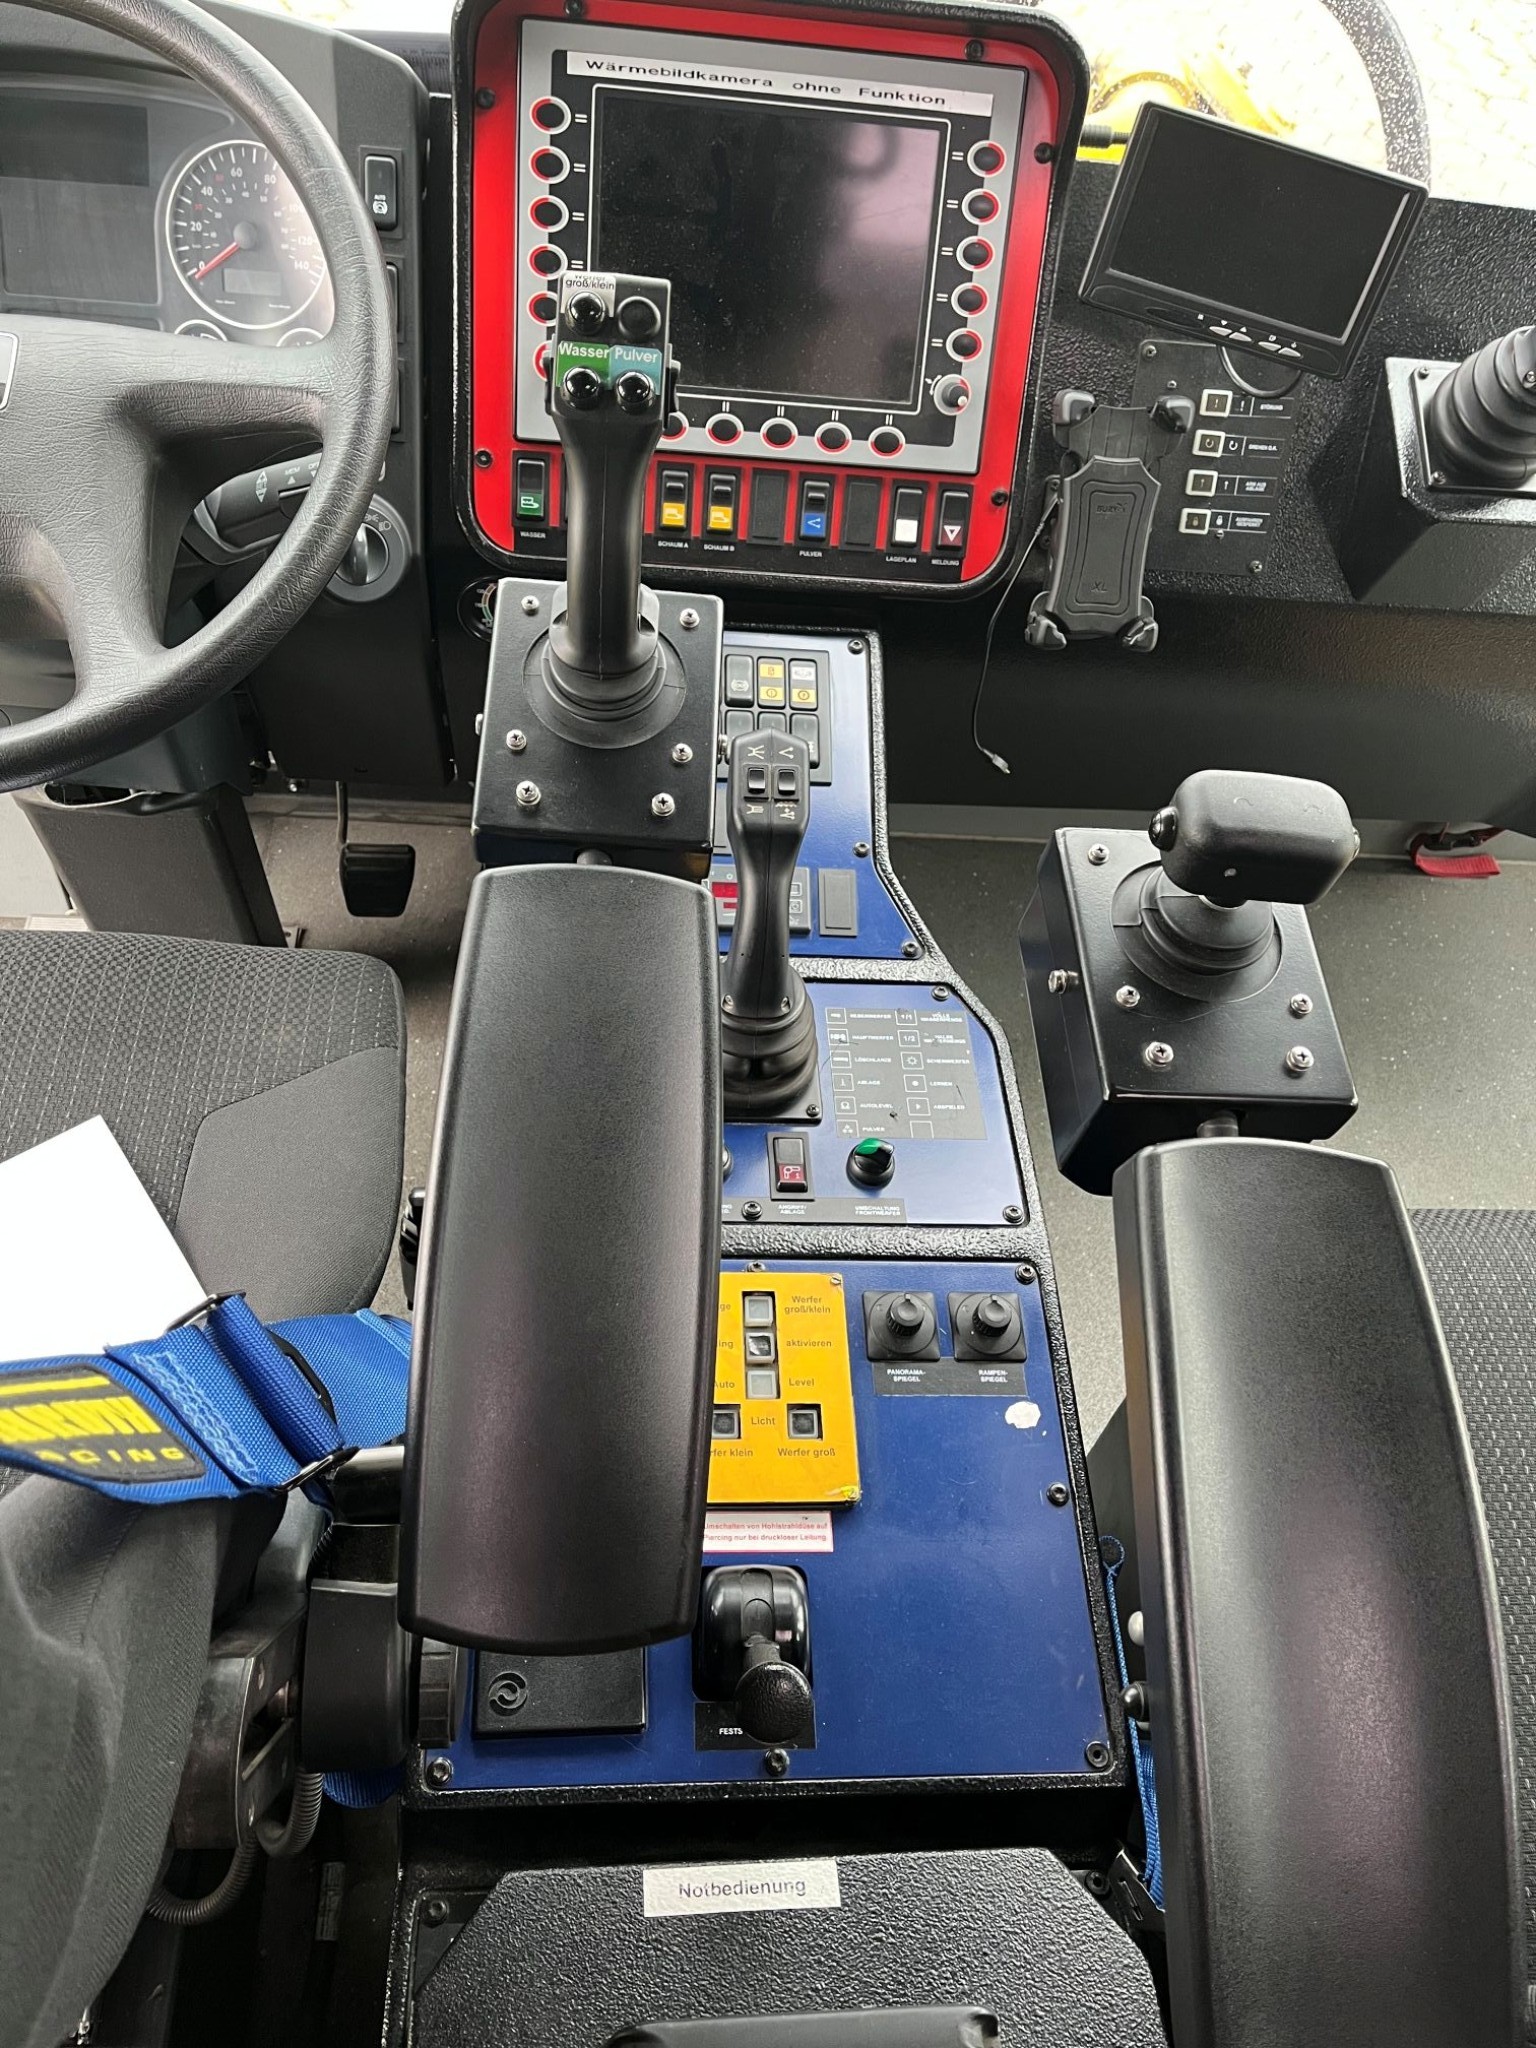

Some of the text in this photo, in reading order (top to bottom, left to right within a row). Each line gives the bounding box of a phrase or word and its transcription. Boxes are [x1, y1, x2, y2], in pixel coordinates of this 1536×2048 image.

[586, 60, 946, 106] Wärmebildkamera ohne Funktion
[230, 167, 243, 178] 60
[200, 186, 213, 196] 40
[190, 221, 202, 232] 20
[294, 260, 310, 271] 140
[565, 279, 615, 290] groß/klein
[560, 342, 611, 359] Wasser
[614, 348, 657, 363] Pulver
[520, 530, 546, 539] WASSER
[657, 540, 684, 549] SCHAUM
[703, 543, 729, 552] SCHAUM
[799, 550, 823, 558] PULVER
[885, 555, 917, 564] LAGEPLAN
[931, 558, 960, 567] MELDUNG
[791, 1295, 822, 1304] Werfer
[784, 1305, 831, 1314] groß/klein
[786, 1339, 832, 1347] aktivieren
[886, 1368, 926, 1376] PANORAMA-
[788, 1377, 815, 1387] Level
[893, 1375, 921, 1383] SPIEGEL
[980, 1375, 1009, 1383] SPIEGEL
[750, 1416, 776, 1425] Licht
[730, 1448, 754, 1457] klein
[778, 1448, 836, 1459] Werfer groß
[800, 1534, 827, 1542] Leitung
[678, 1879, 807, 1898] Notbedienung
